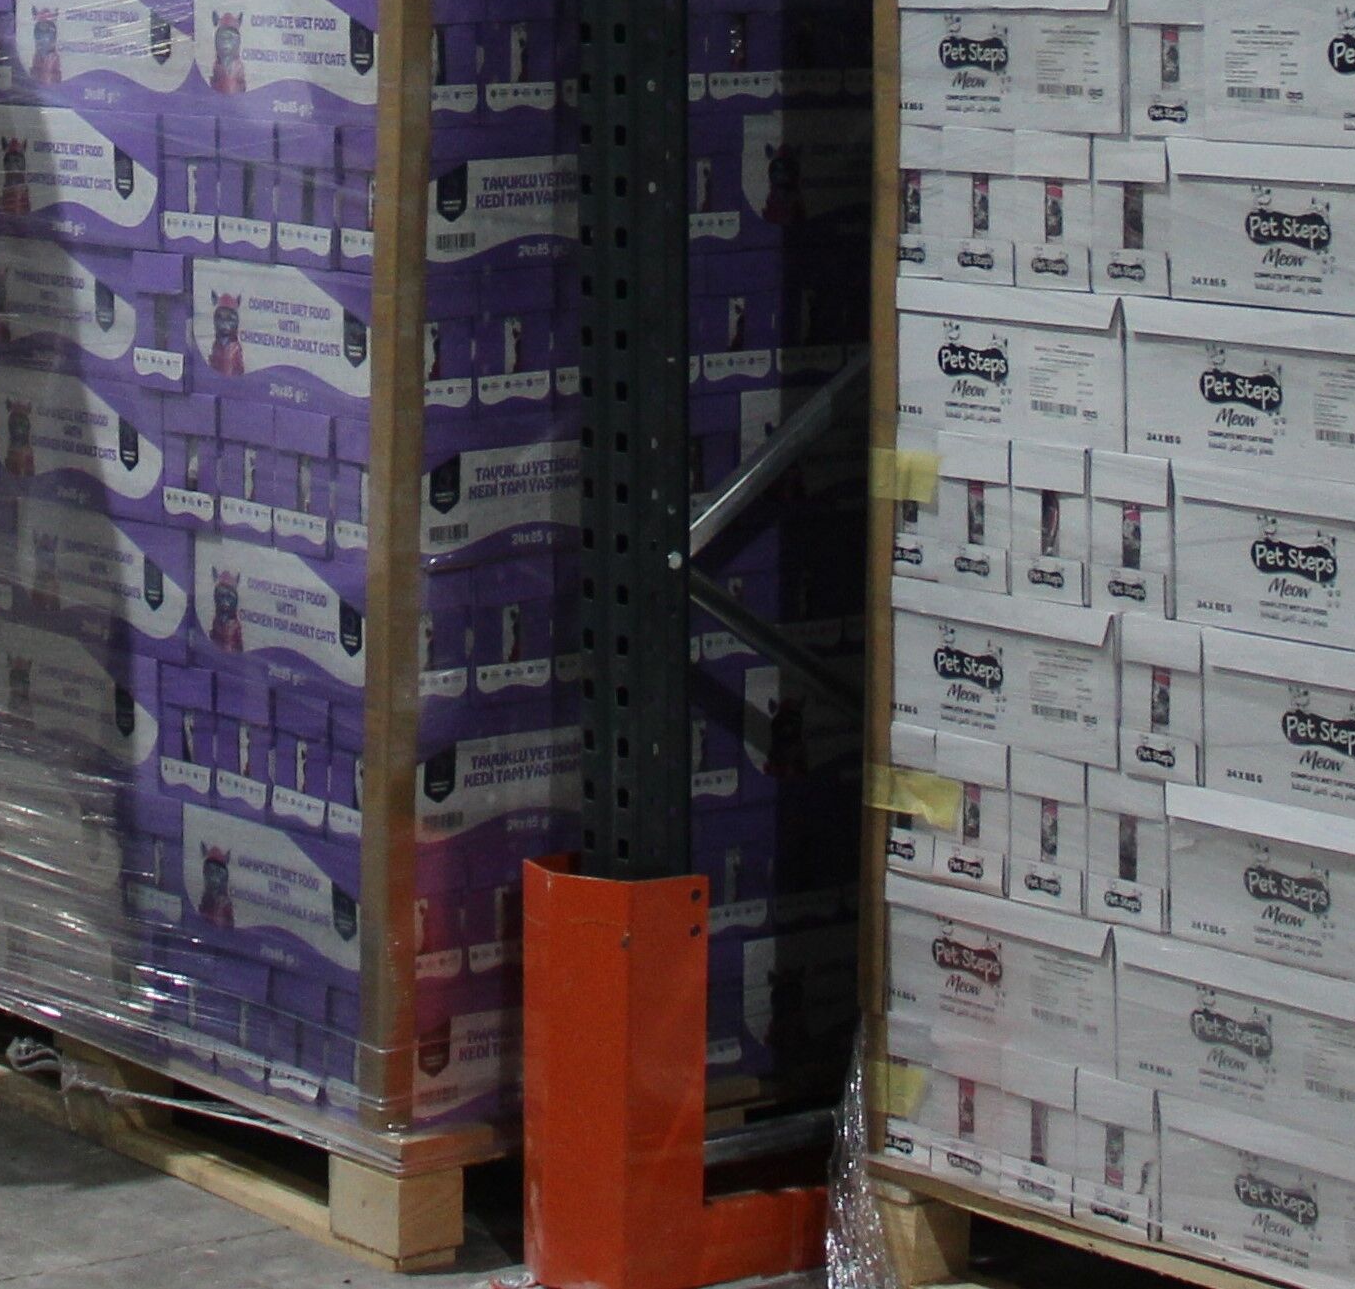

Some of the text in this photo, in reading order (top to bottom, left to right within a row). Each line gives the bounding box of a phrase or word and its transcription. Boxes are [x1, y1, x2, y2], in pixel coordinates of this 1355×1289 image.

[943, 43, 1007, 70] Pet Steps
[952, 72, 988, 89] Meow
[1250, 216, 1327, 248] Pet Steps
[1262, 248, 1308, 267] Meow
[942, 350, 1006, 379] Pet Steps
[952, 380, 988, 397] Meow
[1204, 375, 1280, 409] Pet Steps
[1216, 408, 1260, 428] Meow
[1256, 545, 1333, 580] Pet Steps
[1268, 578, 1311, 598] Meow
[938, 654, 1001, 688] Pet Steps
[947, 685, 981, 703] Meow
[1287, 717, 1315, 738] Pet
[1300, 750, 1344, 771] Meow
[1248, 871, 1326, 910] Pet Steps
[1261, 905, 1305, 927] Meow
[1239, 1179, 1316, 1221] Pet Steps
[1252, 1214, 1294, 1237] Meow
